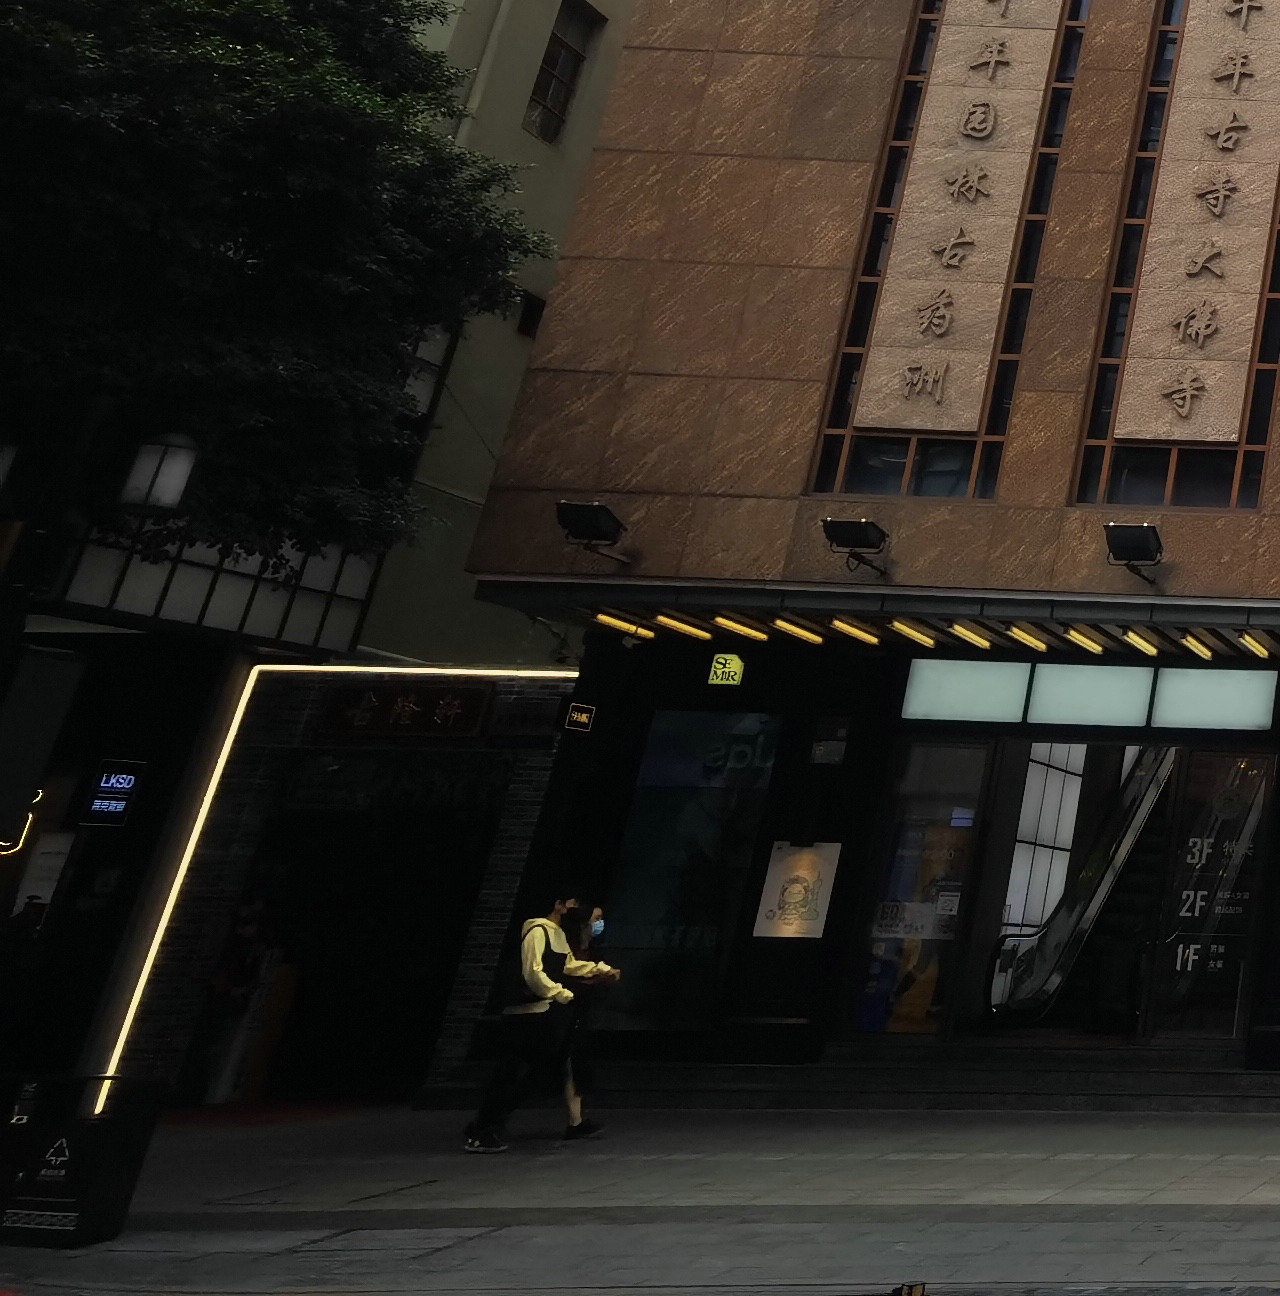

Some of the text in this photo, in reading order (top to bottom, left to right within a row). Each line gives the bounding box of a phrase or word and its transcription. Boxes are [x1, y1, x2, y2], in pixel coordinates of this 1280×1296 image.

[100, 773, 135, 788] LKSD
[1186, 837, 1215, 864] 3F
[1178, 890, 1209, 917] 2F
[1175, 943, 1201, 972] 1F
